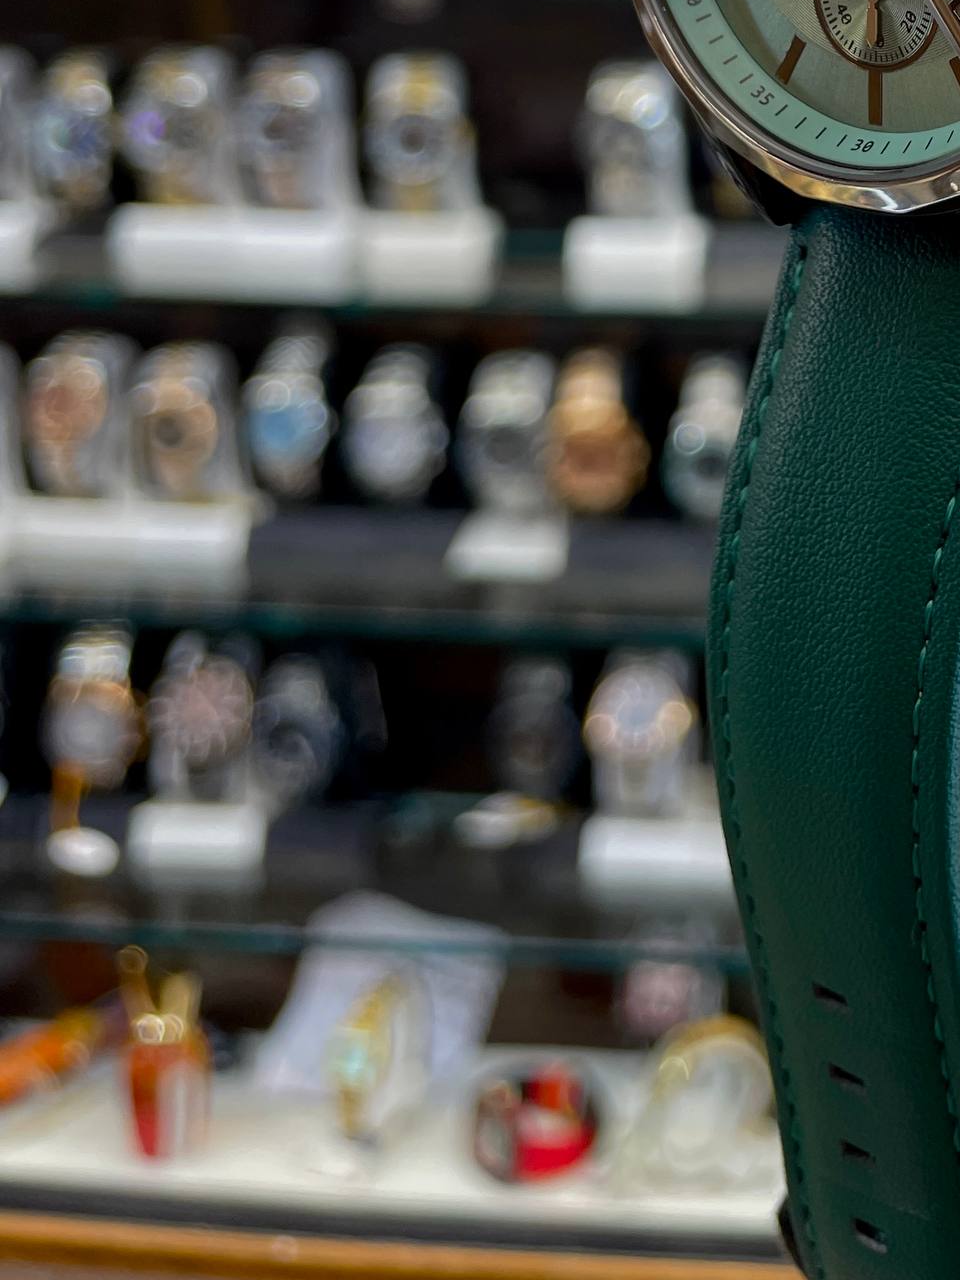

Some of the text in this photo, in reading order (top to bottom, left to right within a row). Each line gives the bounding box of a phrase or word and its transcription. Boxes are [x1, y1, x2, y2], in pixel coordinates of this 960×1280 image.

[837, 3, 852, 25] 40
[900, 10, 917, 34] 20
[750, 84, 775, 106] 35
[850, 139, 875, 154] 30
